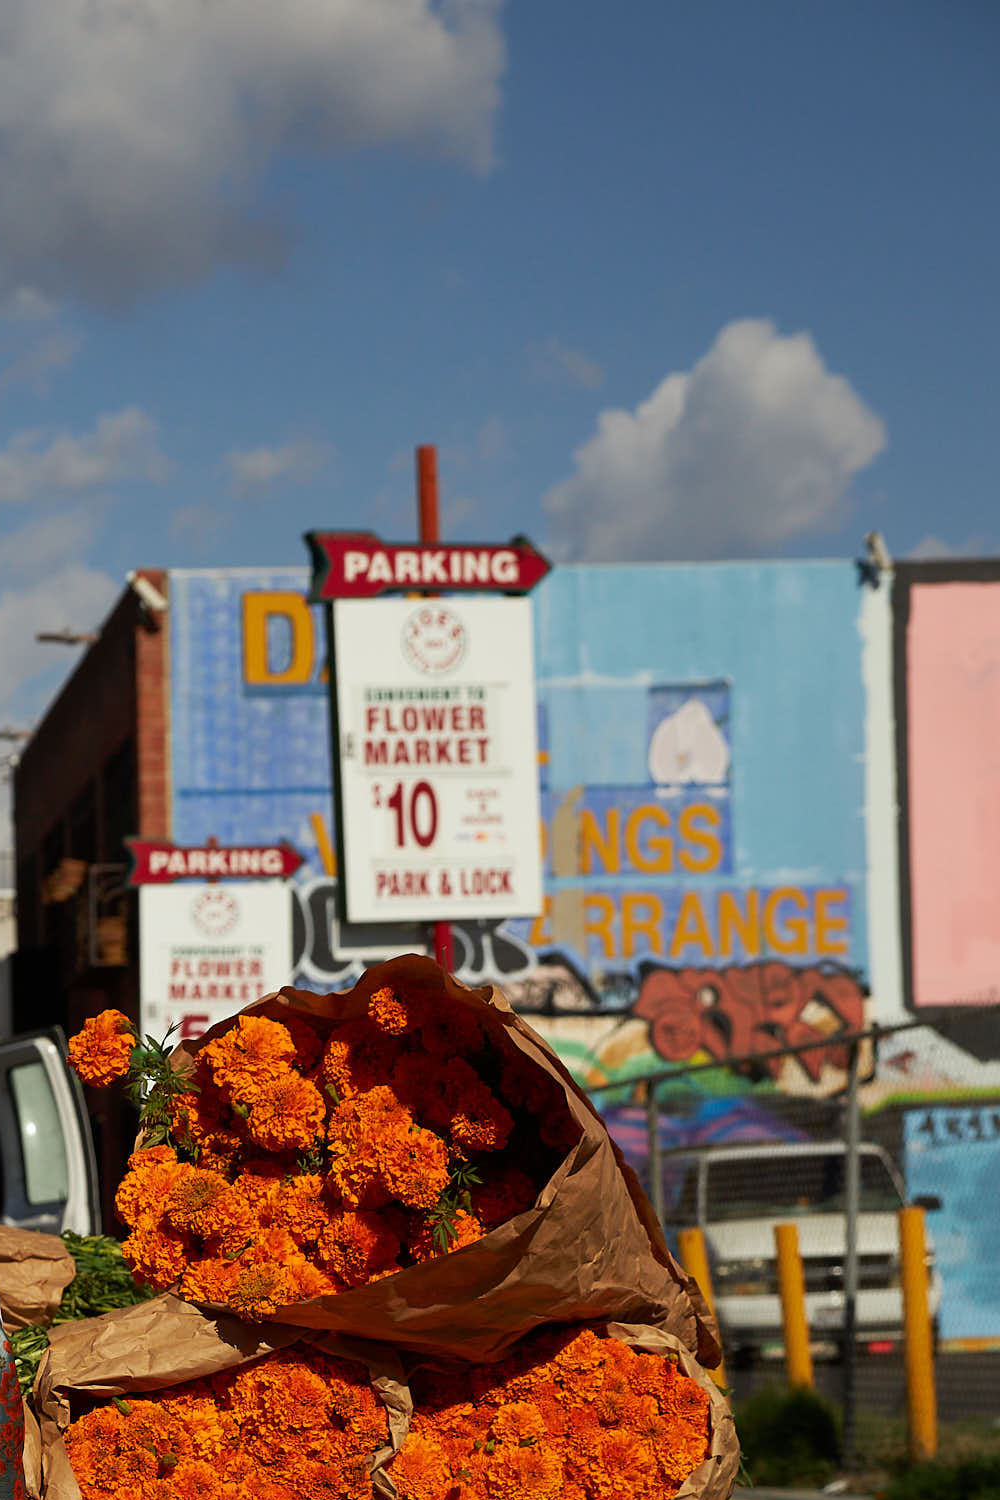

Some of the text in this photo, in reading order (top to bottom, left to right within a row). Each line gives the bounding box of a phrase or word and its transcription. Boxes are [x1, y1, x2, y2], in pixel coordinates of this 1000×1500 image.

[343, 551, 520, 583] PARKING
[365, 706, 486, 732] FLOWER
[364, 738, 489, 765] MARKET
[149, 850, 283, 876] PARKING
[375, 867, 513, 897] PARK & LOCK
[170, 959, 264, 978] FLOWER
[168, 983, 264, 1000] MARKET
